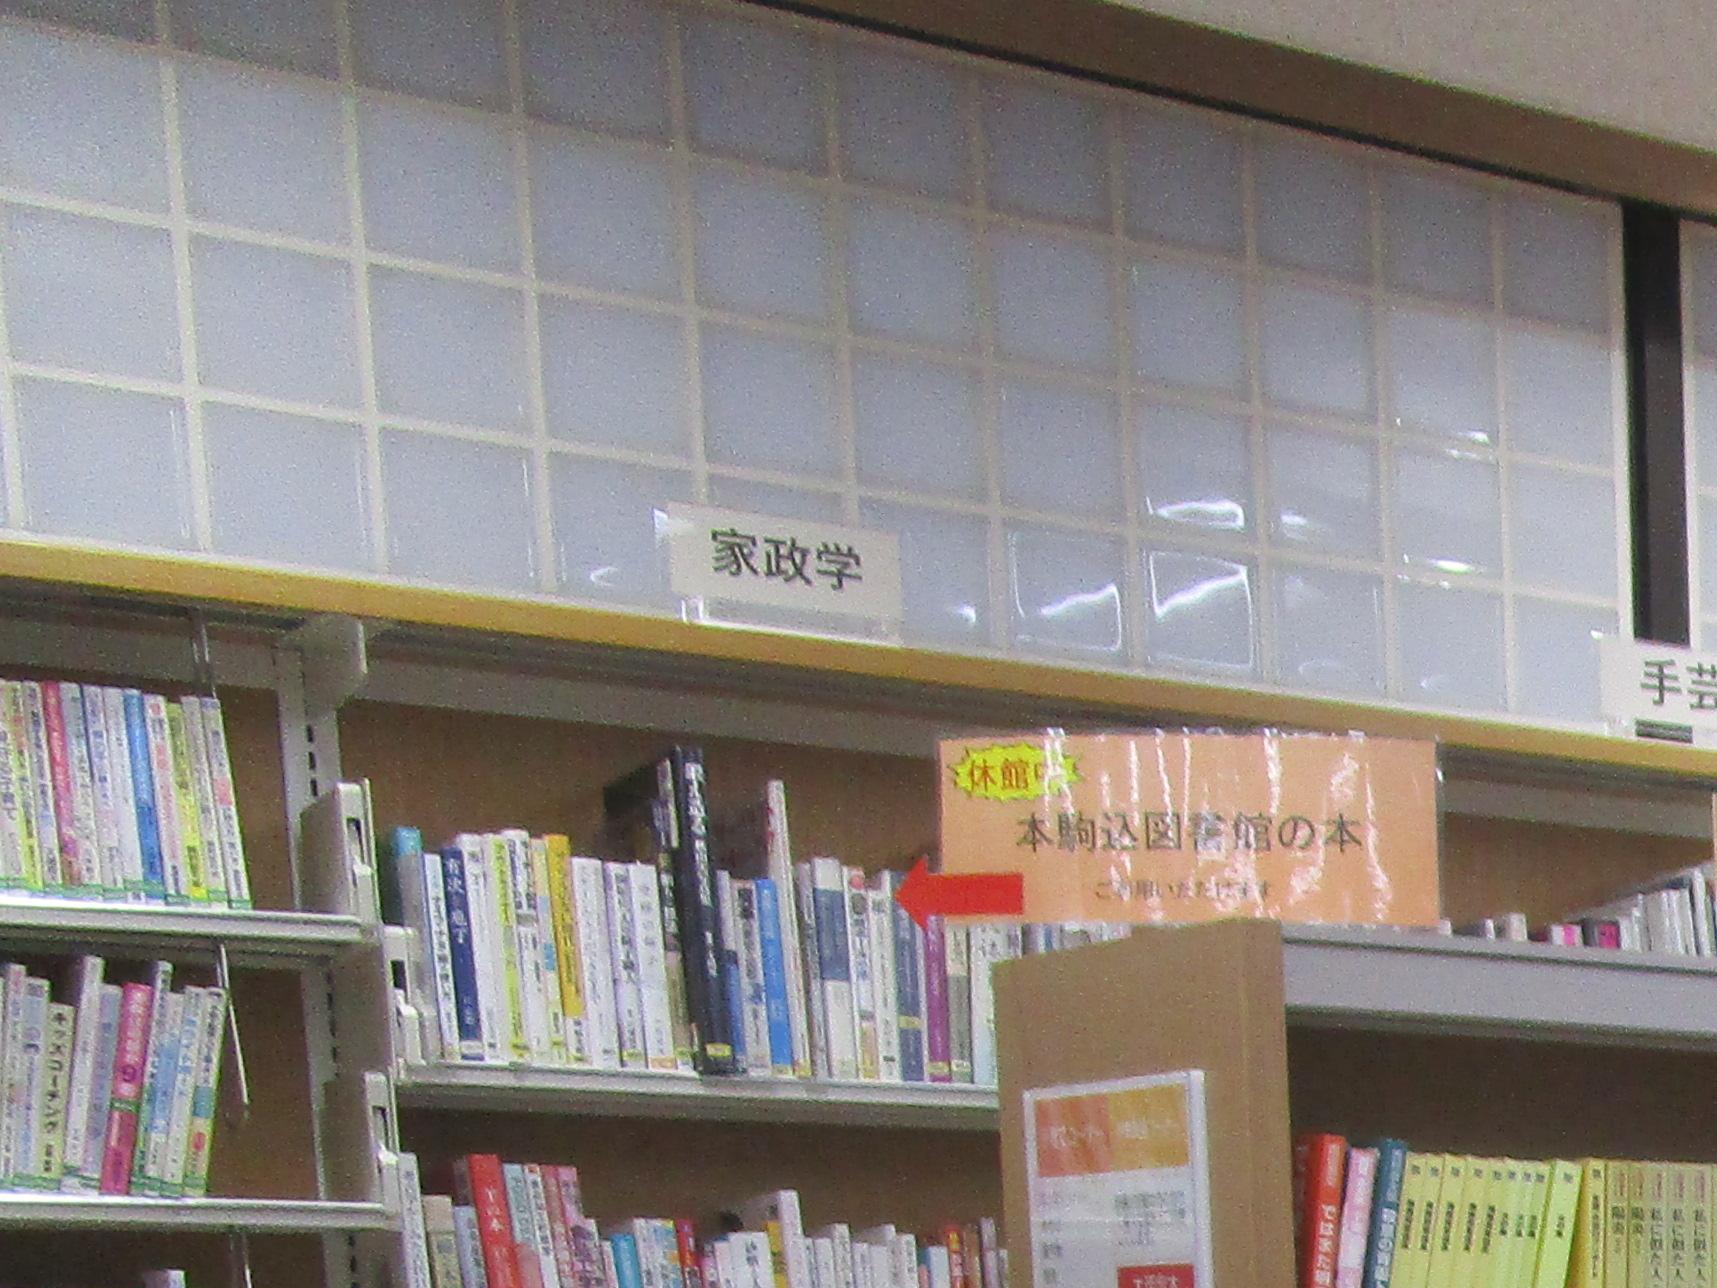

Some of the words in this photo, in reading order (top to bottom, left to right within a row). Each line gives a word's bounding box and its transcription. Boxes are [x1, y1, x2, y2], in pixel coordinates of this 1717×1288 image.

[709, 528, 863, 592] 家政学
[1017, 811, 1363, 854] 本駒込図書館の本
